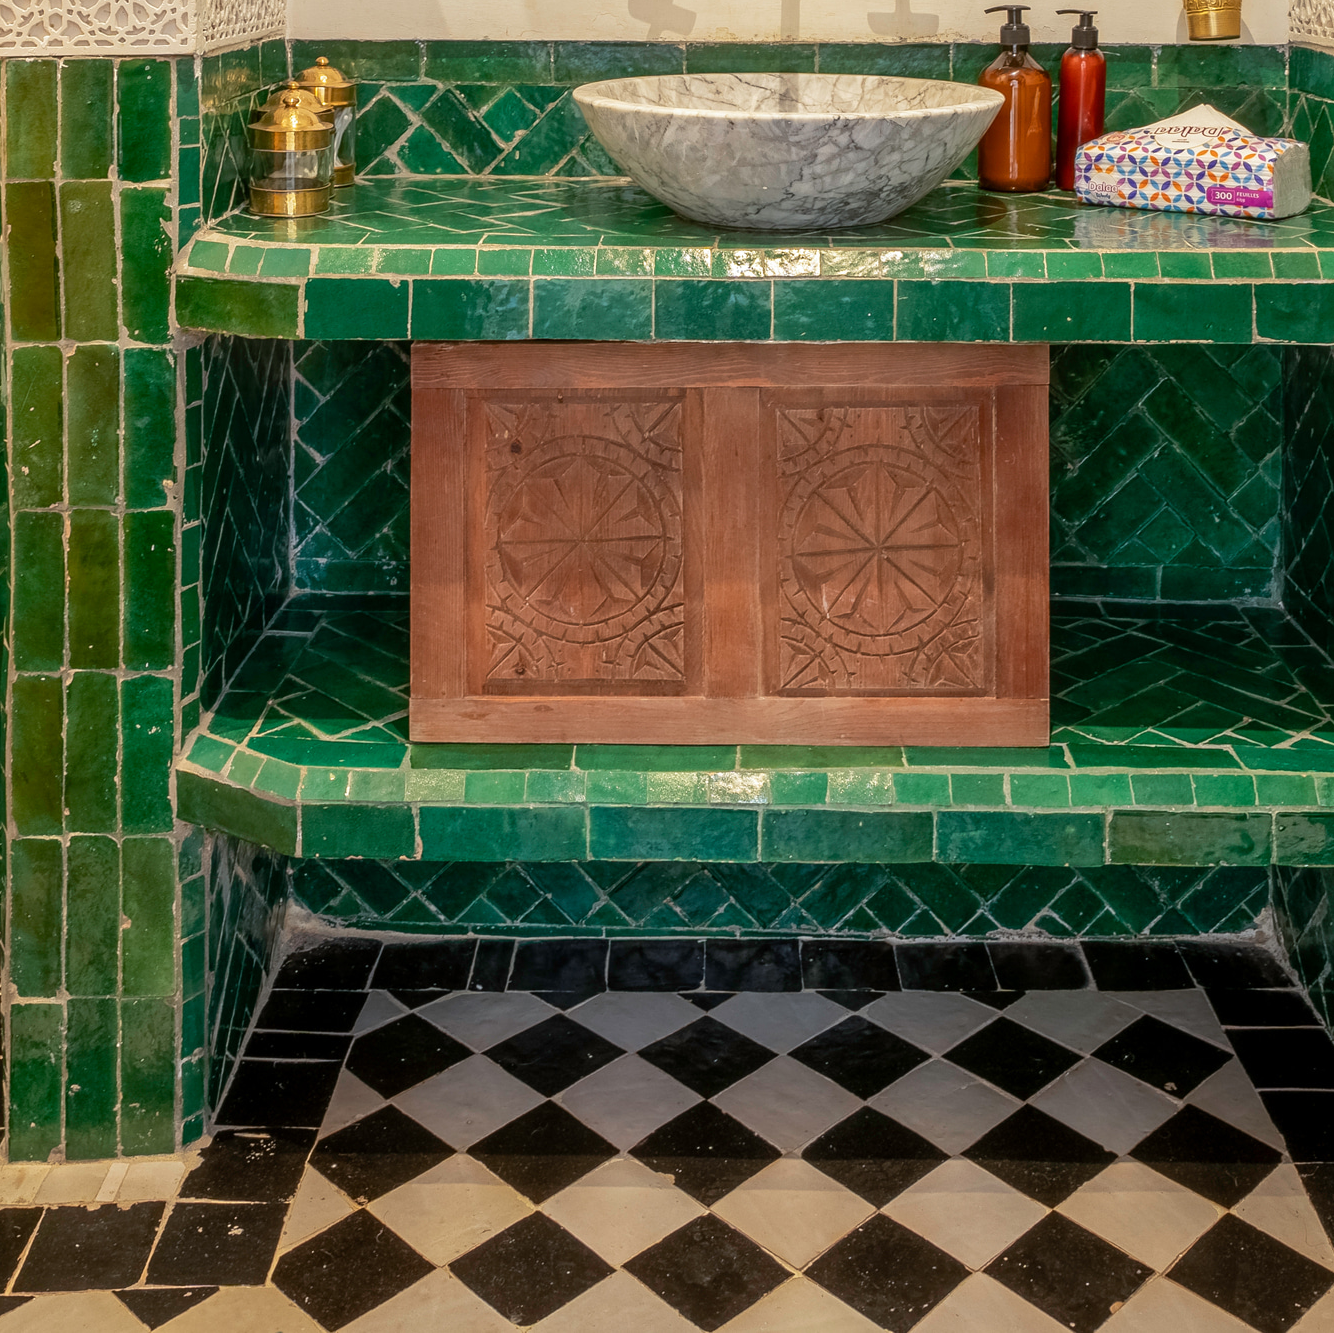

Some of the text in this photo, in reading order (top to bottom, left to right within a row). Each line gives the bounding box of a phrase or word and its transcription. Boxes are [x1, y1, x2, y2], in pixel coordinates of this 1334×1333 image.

[1153, 126, 1224, 138] Dalaa
[1088, 181, 1119, 193] Dalaa
[1214, 191, 1233, 201] 300
[1236, 191, 1260, 199] FEUILLES
